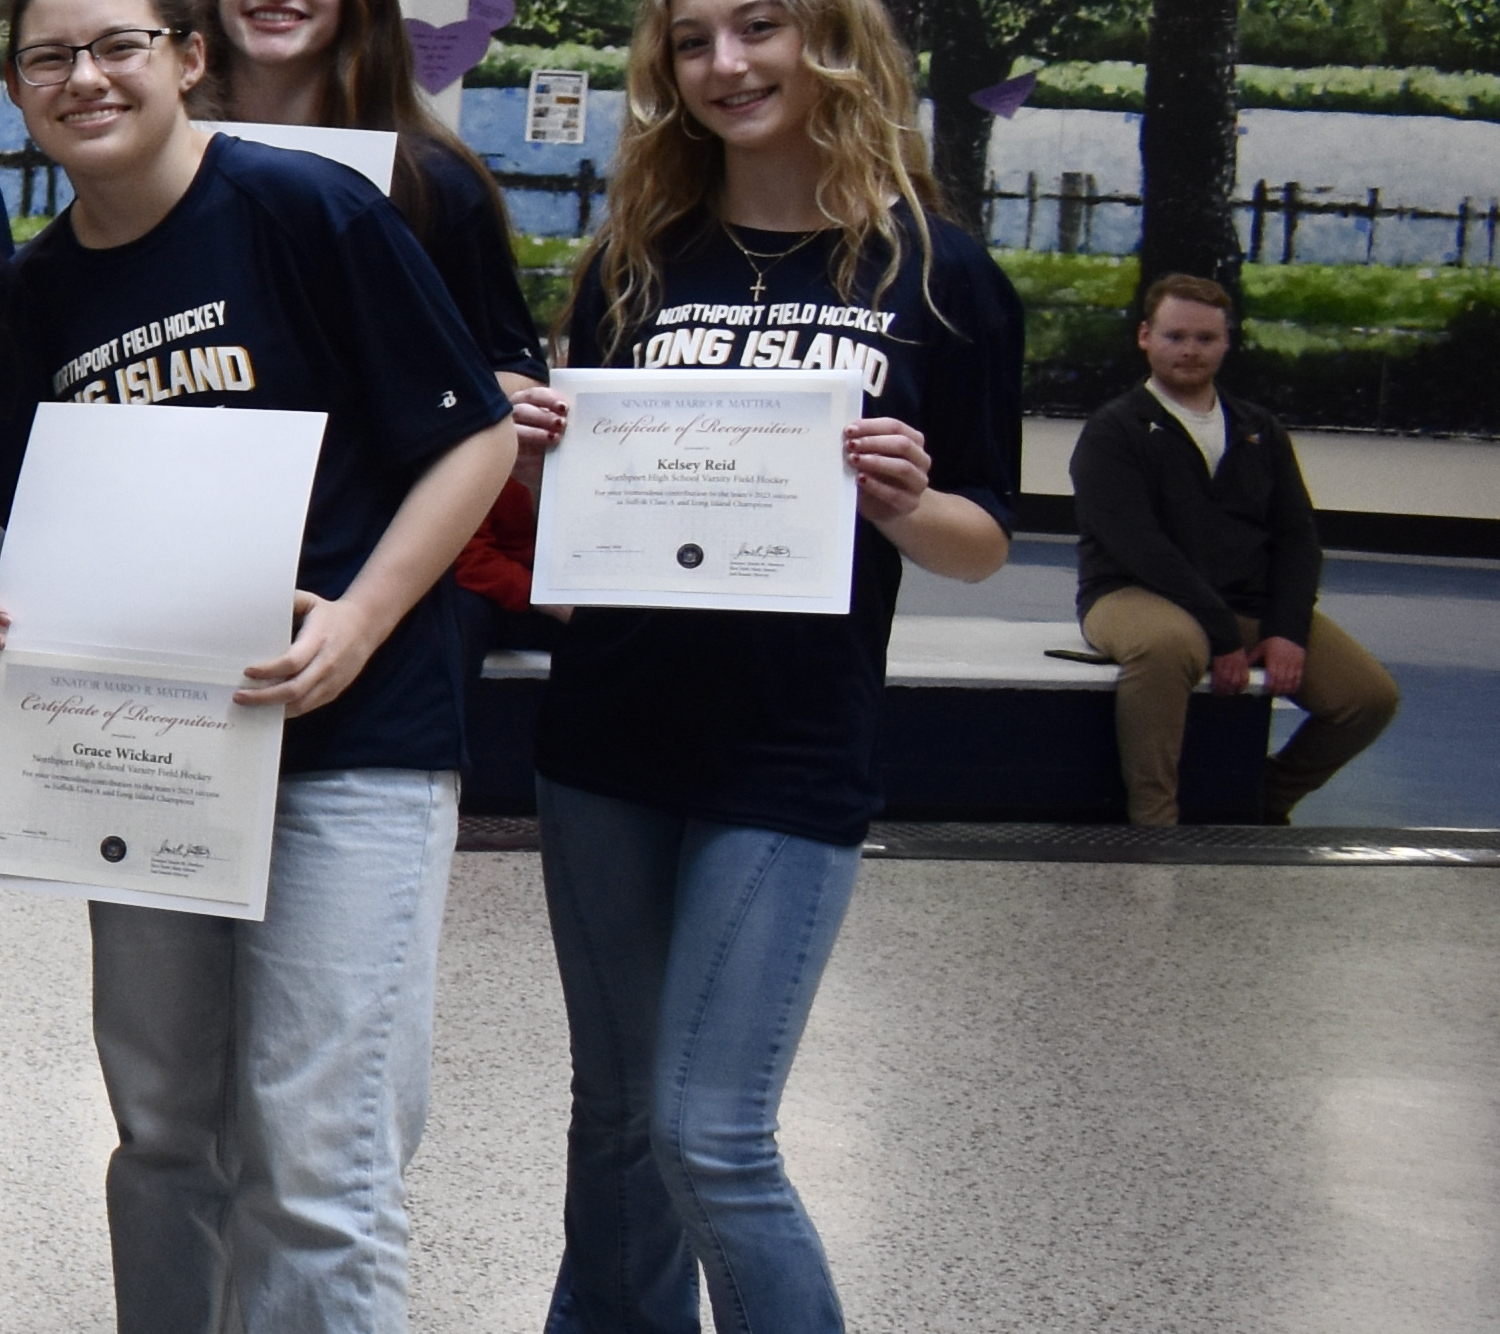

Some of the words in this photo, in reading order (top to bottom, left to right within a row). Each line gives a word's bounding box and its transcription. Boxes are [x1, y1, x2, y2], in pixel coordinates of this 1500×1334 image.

[123, 321, 162, 359] FIELD
[165, 301, 227, 342] HOCKEY
[656, 303, 764, 325] NORTHPORT
[767, 303, 816, 325] FIELD
[817, 306, 895, 333] HOCKEY
[116, 345, 255, 406] ISLAND
[633, 328, 733, 370] LONG
[740, 331, 889, 398] ISLAND
[621, 399, 671, 409] SENATOR
[725, 399, 781, 409] MATTERA
[592, 415, 671, 445] Certificate
[675, 415, 701, 445] of
[696, 418, 810, 446] Recognition
[657, 459, 701, 474] Kelsey
[705, 459, 735, 471] Reid
[21, 692, 98, 725] Certificate
[102, 700, 125, 732] of
[125, 703, 234, 736] Recognition
[73, 741, 111, 758] Grace
[116, 746, 172, 765] Wickard
